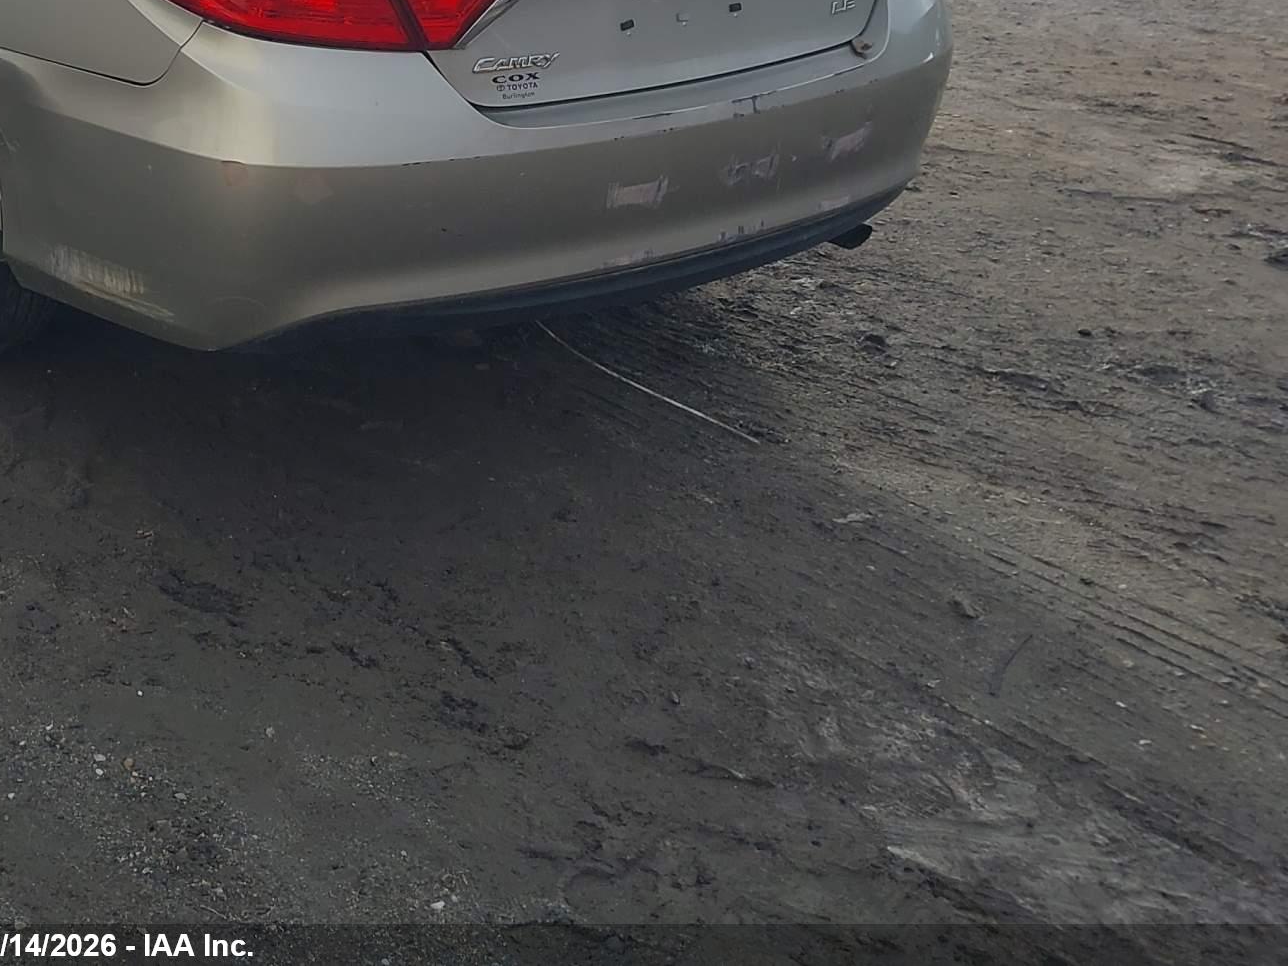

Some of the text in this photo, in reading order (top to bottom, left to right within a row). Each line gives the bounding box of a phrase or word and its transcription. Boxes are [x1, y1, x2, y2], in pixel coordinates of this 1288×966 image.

[472, 51, 560, 74] CAMRY
[492, 72, 540, 84] COX
[507, 82, 538, 91] TOYOTA
[502, 92, 535, 100] Burlington
